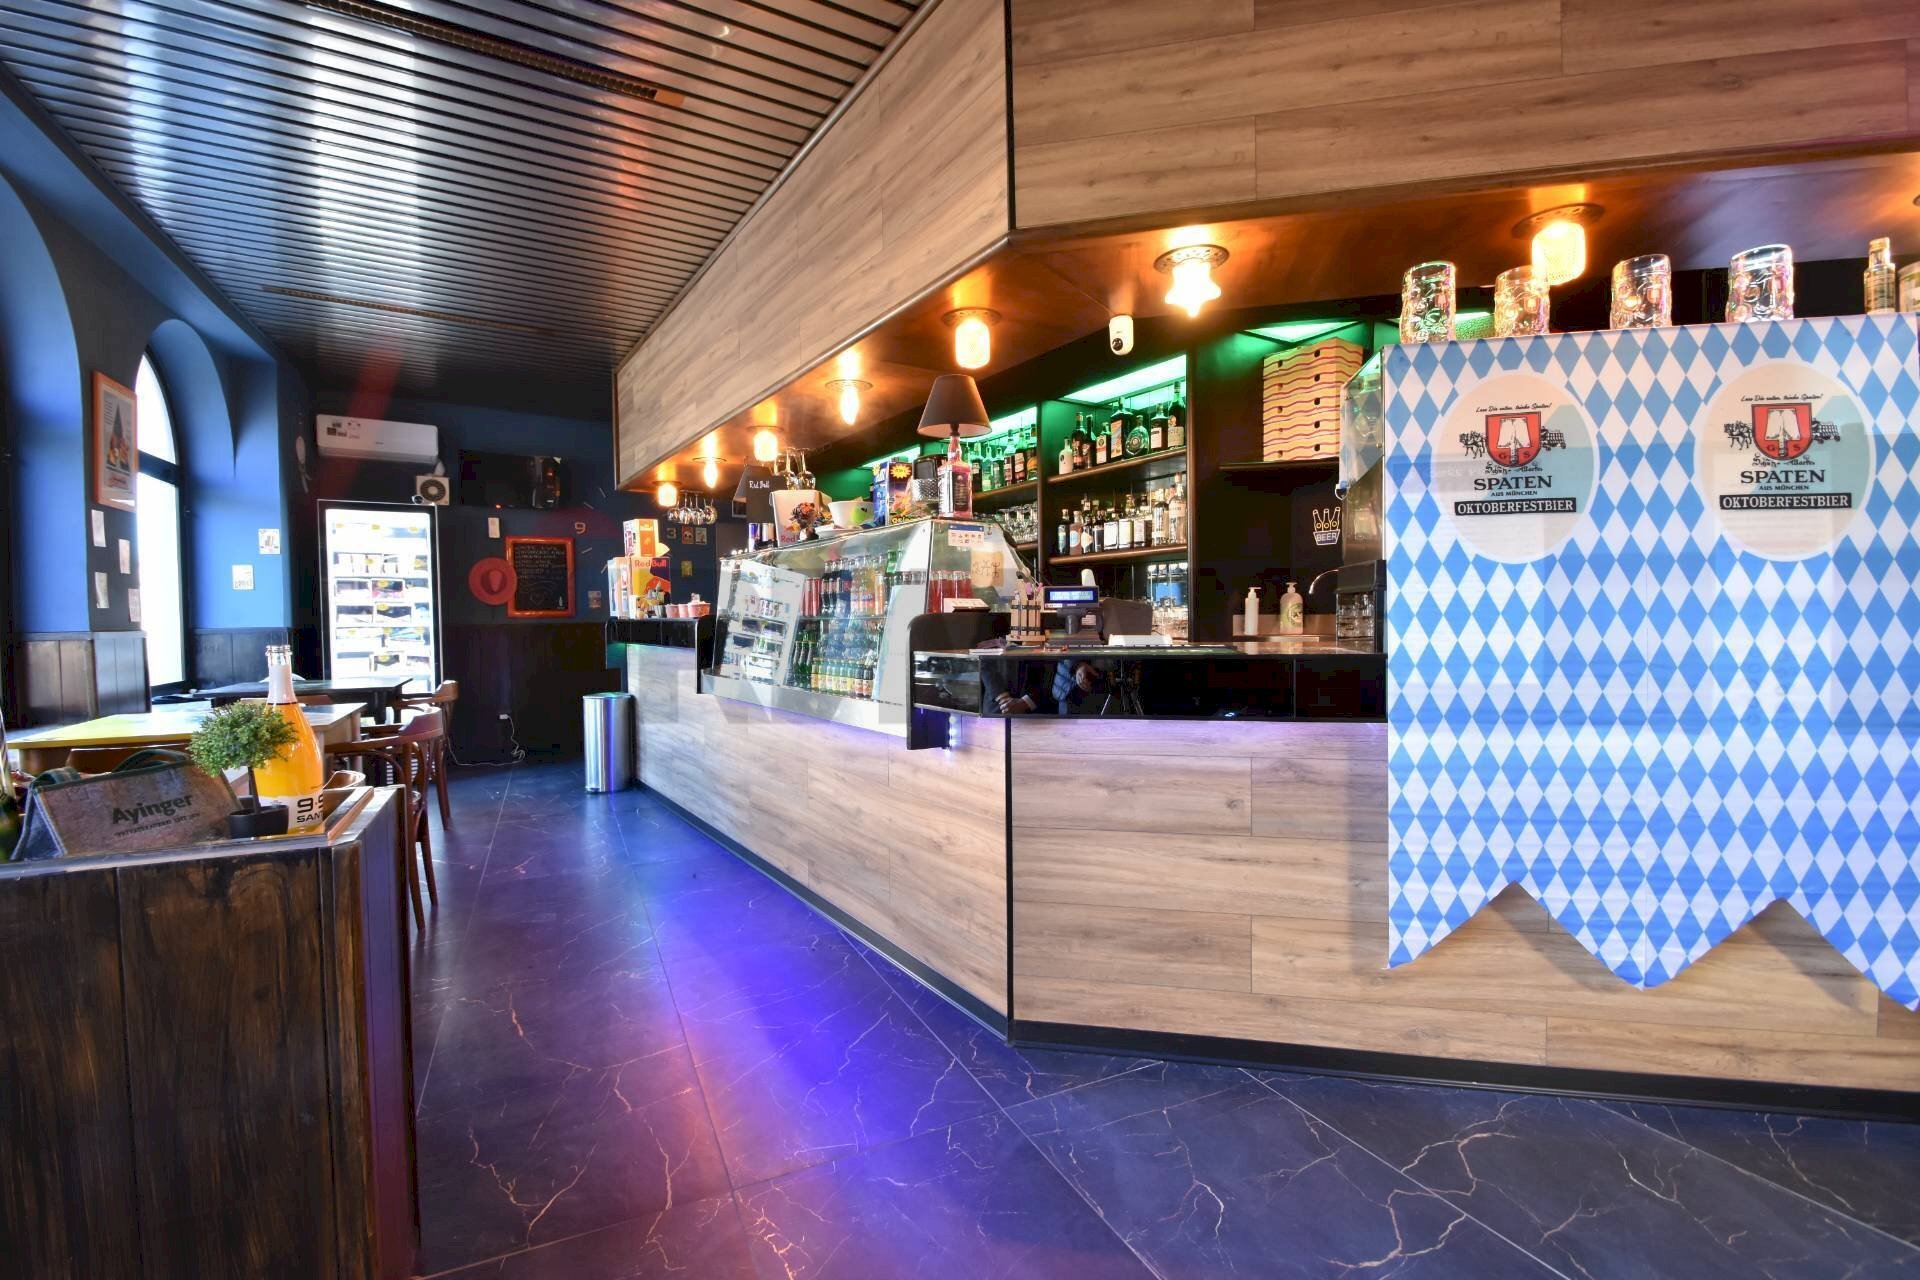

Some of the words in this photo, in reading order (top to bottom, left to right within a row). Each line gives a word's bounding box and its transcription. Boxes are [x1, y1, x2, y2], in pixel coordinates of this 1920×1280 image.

[1473, 475, 1552, 491] SPATEN
[1740, 469, 1826, 484] SPATEN
[1457, 499, 1574, 515] OKTOBERFESTBIER
[1722, 495, 1849, 509] OKTOBERFESTBIER
[1316, 532, 1337, 542] BEER
[634, 559, 651, 568] Red
[112, 794, 192, 825] Ayinger
